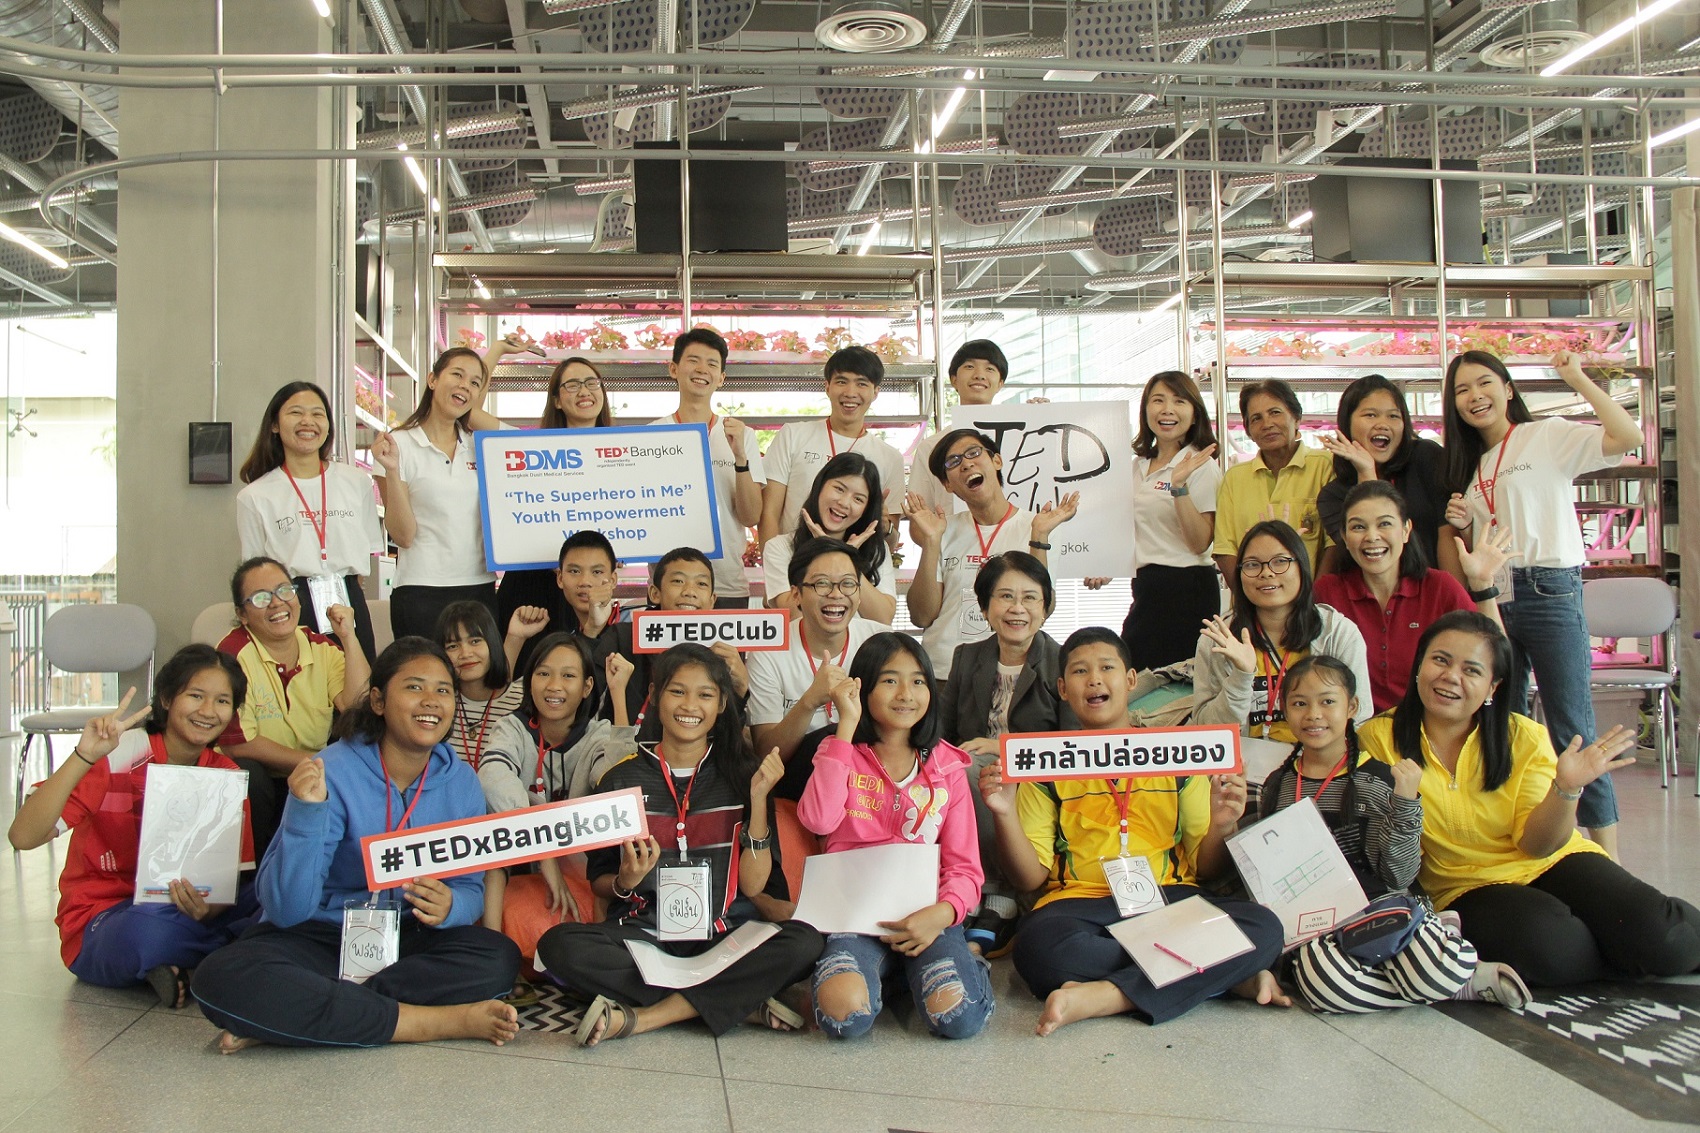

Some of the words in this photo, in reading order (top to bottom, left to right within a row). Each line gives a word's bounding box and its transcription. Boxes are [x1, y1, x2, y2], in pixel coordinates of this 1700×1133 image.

[505, 448, 584, 471] BDMS
[973, 421, 1111, 486] TED
[551, 486, 636, 504] Superhero
[641, 486, 657, 499] in
[512, 509, 561, 524] Youth
[566, 504, 686, 523] Empowerment
[562, 527, 647, 541] Wkshop
[645, 620, 778, 642] #TEDClub
[1014, 738, 1226, 771] #กล้าปล่อยของ
[380, 803, 632, 873] #TEDxBangkok
